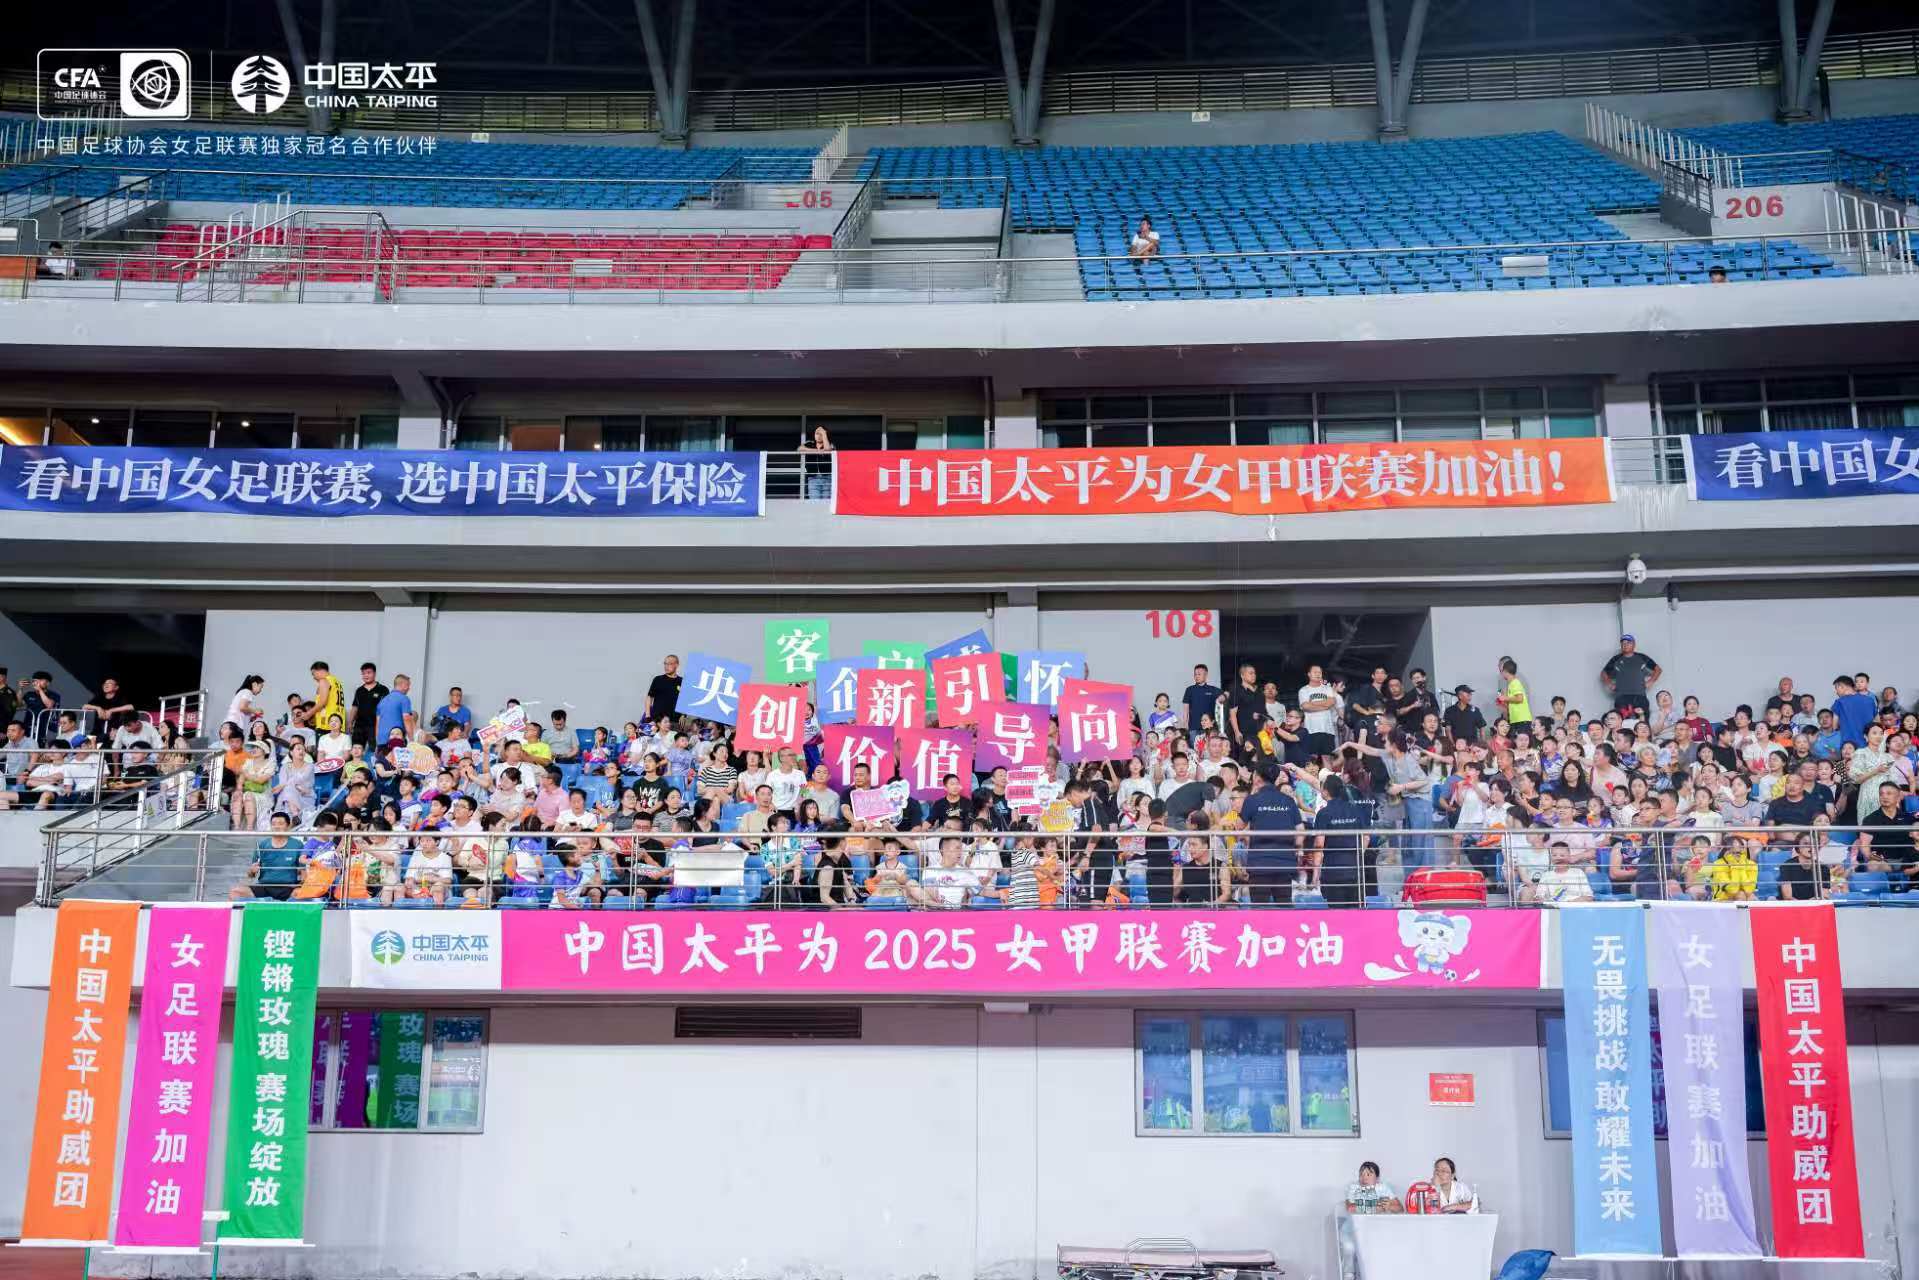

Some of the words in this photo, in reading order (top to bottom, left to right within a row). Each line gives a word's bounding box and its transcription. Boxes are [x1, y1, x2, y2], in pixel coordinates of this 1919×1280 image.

[784, 190, 832, 208] 05
[1726, 195, 1784, 219] 206
[1146, 610, 1214, 638] 108
[777, 629, 822, 673] 客
[688, 666, 739, 716] 央
[868, 679, 916, 728] 新
[944, 663, 990, 715] 引
[750, 694, 799, 744] 创
[987, 712, 1035, 764] 导
[1071, 704, 1118, 753] 向
[837, 736, 887, 787] 价
[912, 739, 962, 790] 值
[412, 934, 488, 952] 中国太平
[413, 954, 443, 962] CHINA
[447, 954, 488, 962] TAIPING
[53, 928, 111, 1208] 中国太平助威团
[145, 935, 203, 1215] 女足联赛加油
[1680, 935, 1729, 1222] 女足联赛加油
[1781, 937, 1833, 1225] 中国太平助威团
